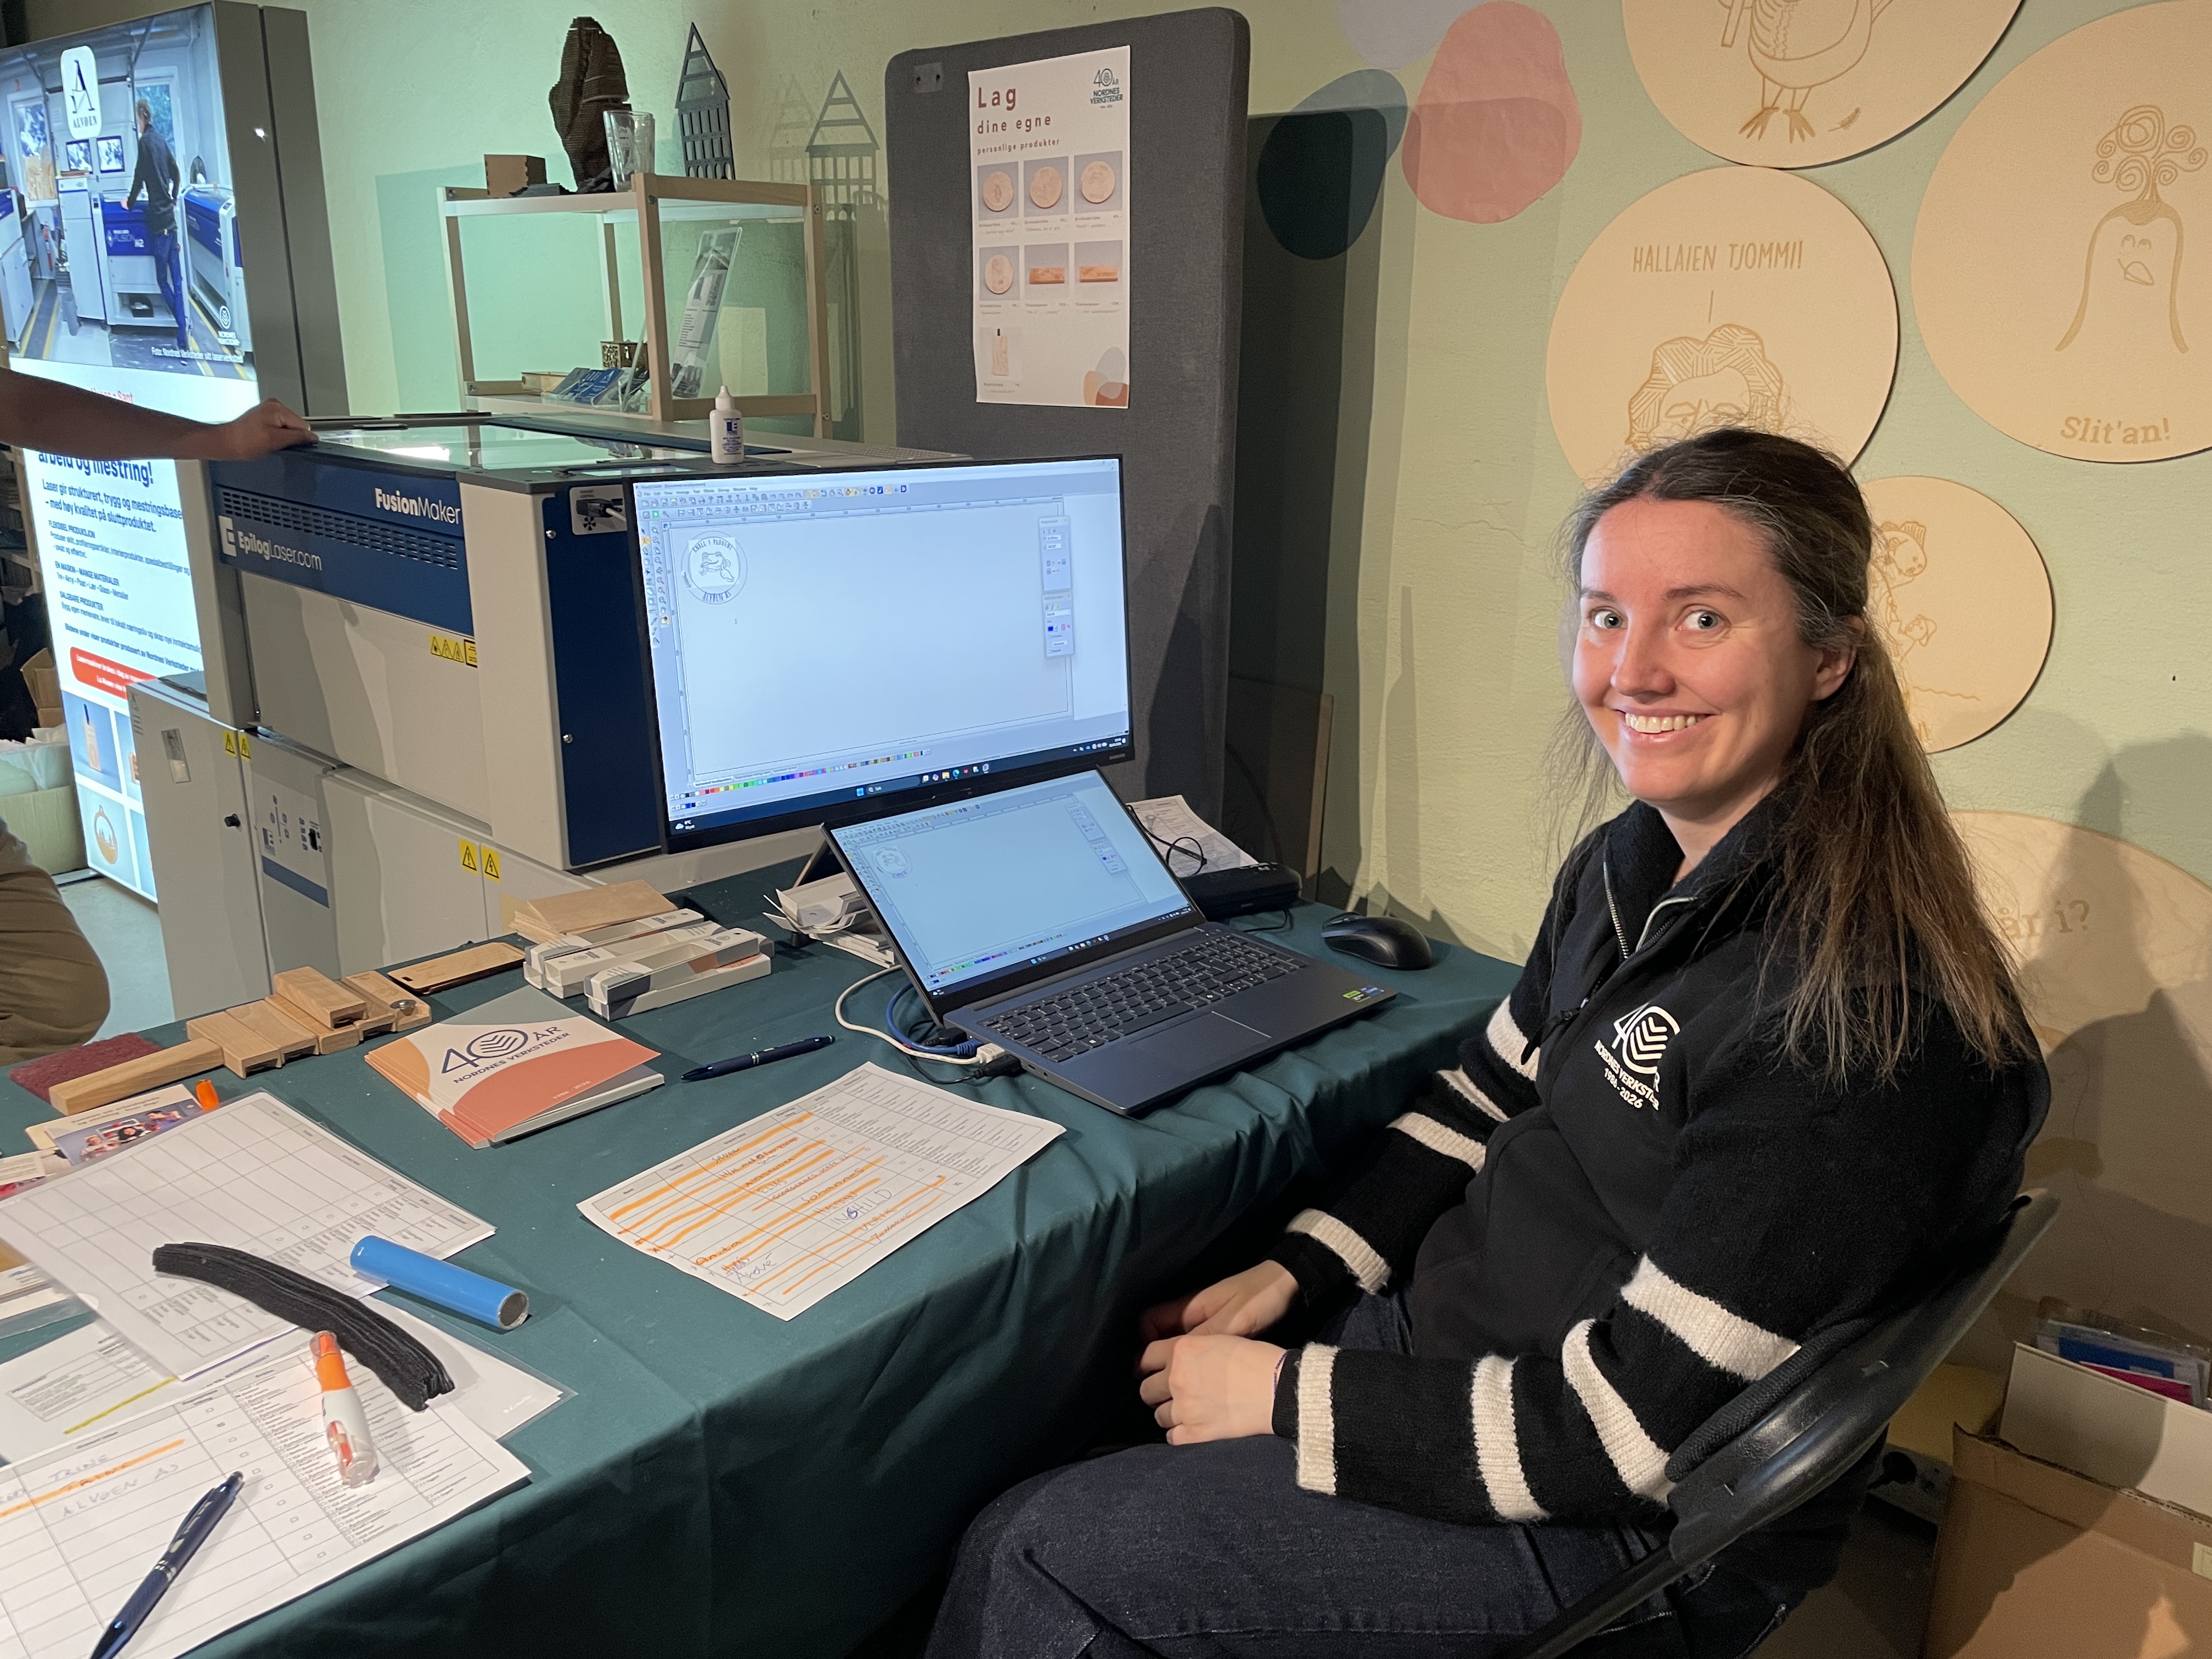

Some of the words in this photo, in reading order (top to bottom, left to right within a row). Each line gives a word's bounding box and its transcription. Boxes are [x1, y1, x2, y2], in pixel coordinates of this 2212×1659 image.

[978, 87, 1016, 111] Lag
[1093, 87, 1119, 97] NORDNES
[978, 121, 1007, 134] dine
[1016, 116, 1051, 132] egne
[977, 144, 1016, 155] personlige
[1020, 138, 1060, 151] produkter
[1633, 245, 1717, 273] HALLAIEN
[2061, 416, 2170, 444] Slit'an!
[93, 461, 153, 487] mestring!
[42, 479, 58, 492] Laser
[68, 486, 104, 504] strukturert,
[104, 493, 121, 509] trygg
[122, 499, 131, 511] og
[375, 487, 461, 524] FusionMaker
[50, 499, 62, 510] med
[63, 502, 74, 515] høy
[74, 503, 97, 518] kvalitet
[98, 509, 106, 522] på
[238, 530, 323, 571] EpilogLaser.com
[2055, 899, 2090, 934] i?
[441, 1029, 528, 1074] 40
[533, 1026, 562, 1041] ÅR
[453, 1060, 506, 1084] NORDNES
[507, 1032, 569, 1060] VERKSTEDER
[1594, 1040, 1621, 1074] NORDNES
[1620, 1087, 1644, 1108] 2026
[800, 1167, 864, 1205] Johannes
[858, 1209, 898, 1232] ULRIK
